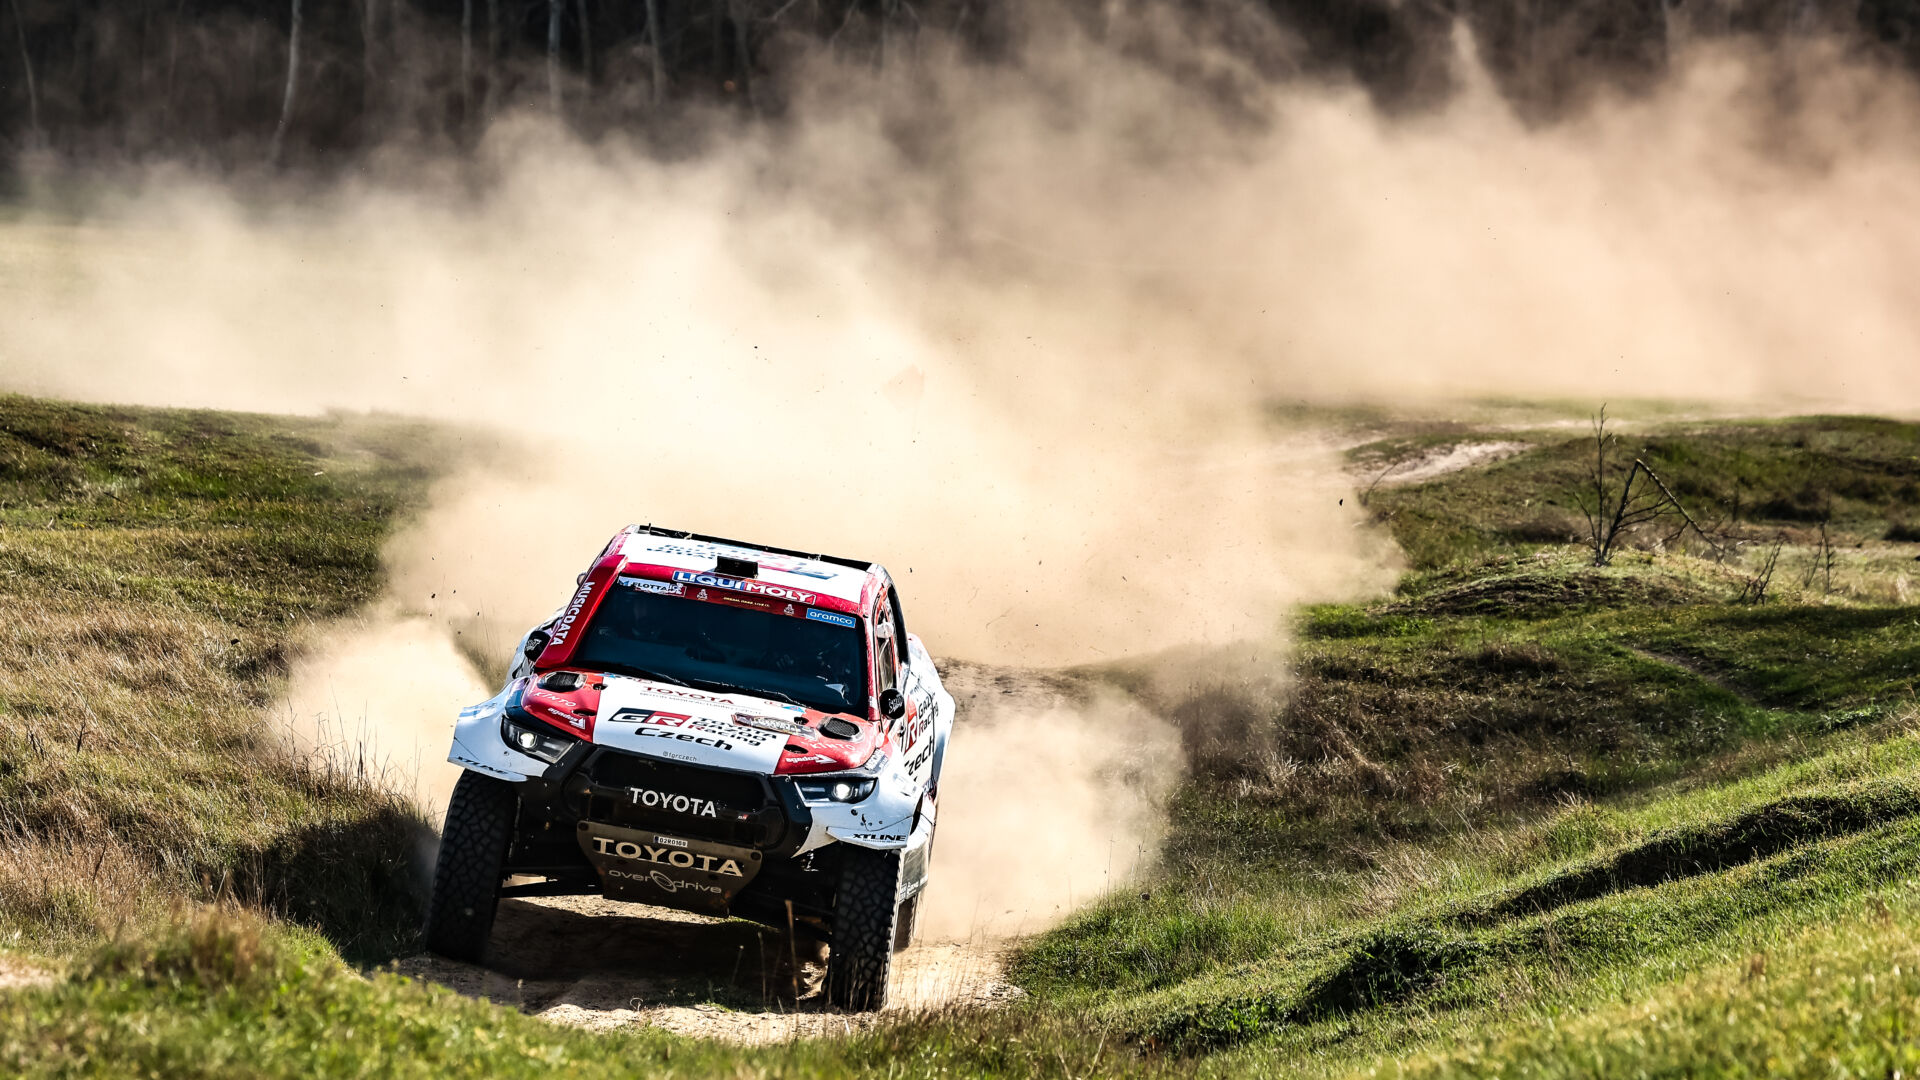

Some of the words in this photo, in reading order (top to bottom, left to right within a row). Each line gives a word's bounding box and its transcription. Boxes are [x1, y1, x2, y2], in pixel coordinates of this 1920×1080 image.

[677, 571, 745, 591] LIQUI
[745, 583, 814, 604] MOLY
[550, 581, 596, 646] MUSICDATA
[809, 610, 853, 625] aramco
[534, 692, 577, 707] KINTO
[644, 686, 735, 704] TOYOTA
[612, 712, 684, 728] GR
[697, 717, 778, 739] TOYOTA
[634, 727, 733, 751] Czech
[687, 724, 761, 746] Racing
[692, 721, 767, 742] GAZOO
[810, 742, 856, 751] KINTO
[630, 787, 717, 818] TOYOTA
[853, 833, 907, 842] XTLINE
[592, 836, 743, 878] TOYOTA
